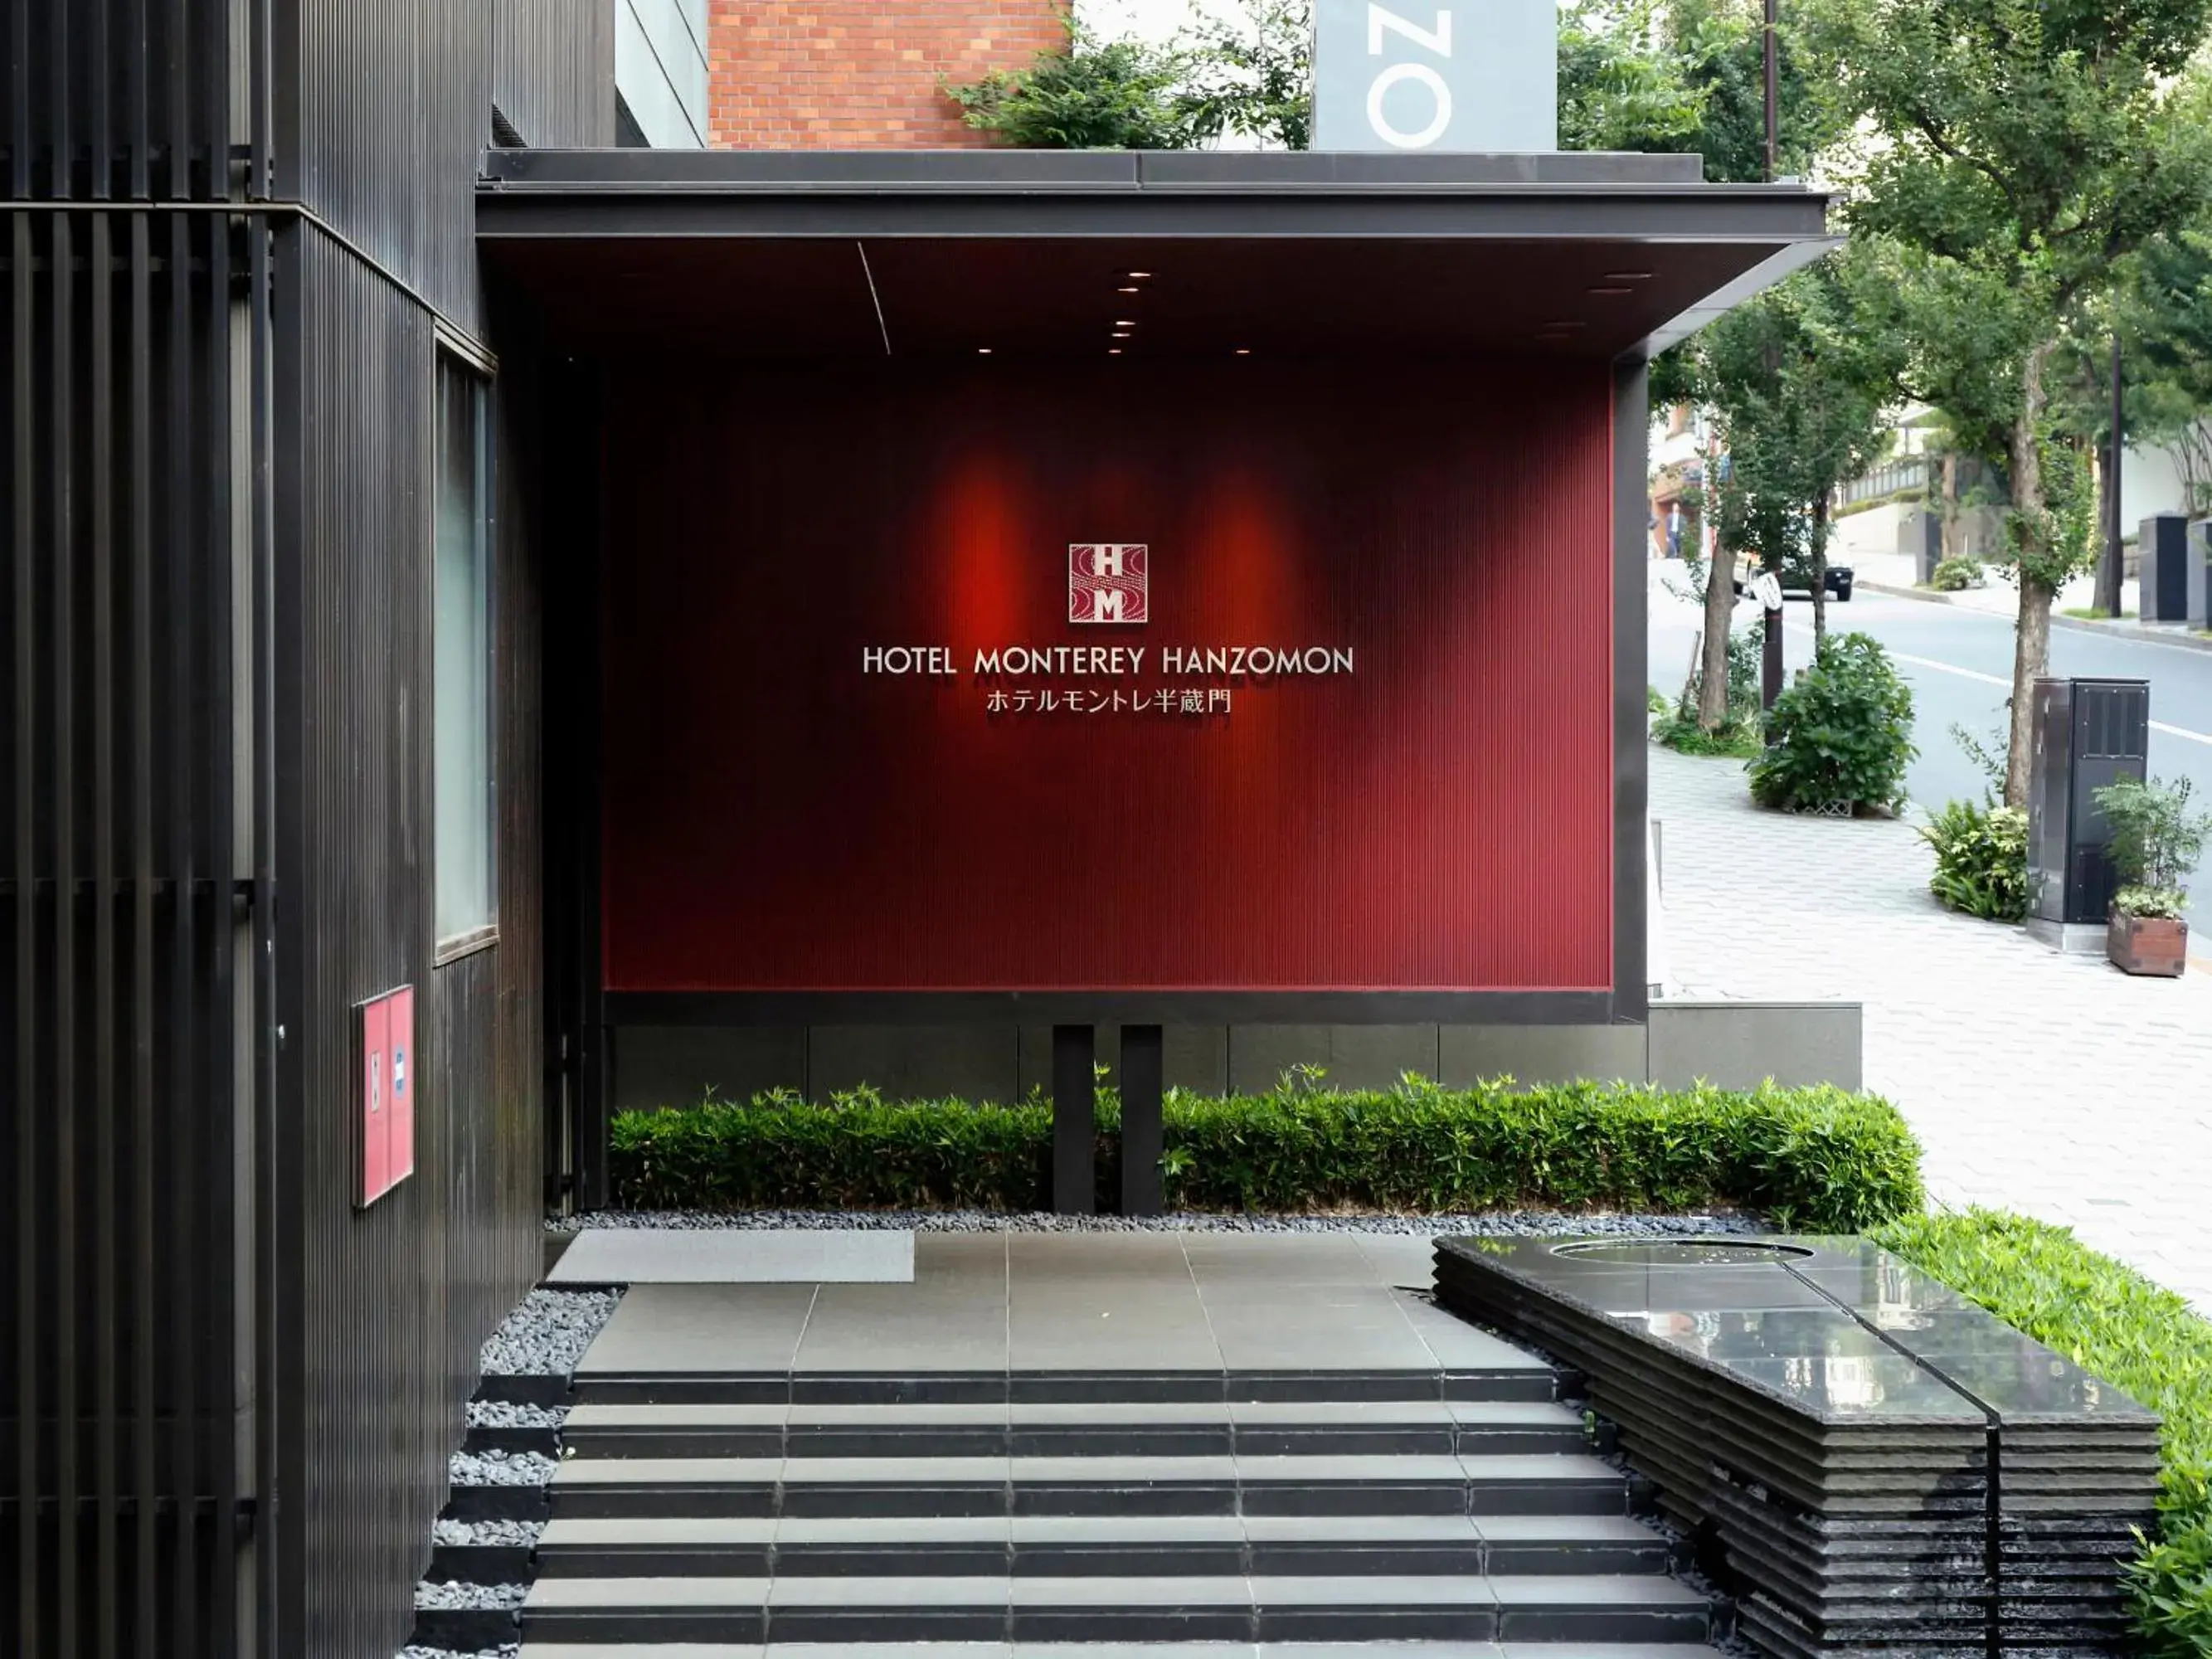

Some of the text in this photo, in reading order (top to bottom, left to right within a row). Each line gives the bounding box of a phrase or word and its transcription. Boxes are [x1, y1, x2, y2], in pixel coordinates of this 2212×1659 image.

[863, 646, 1354, 674] HOTEL MONTEREY HANZOMON
[987, 689, 1232, 713] ホテルモントレ半蔵門
